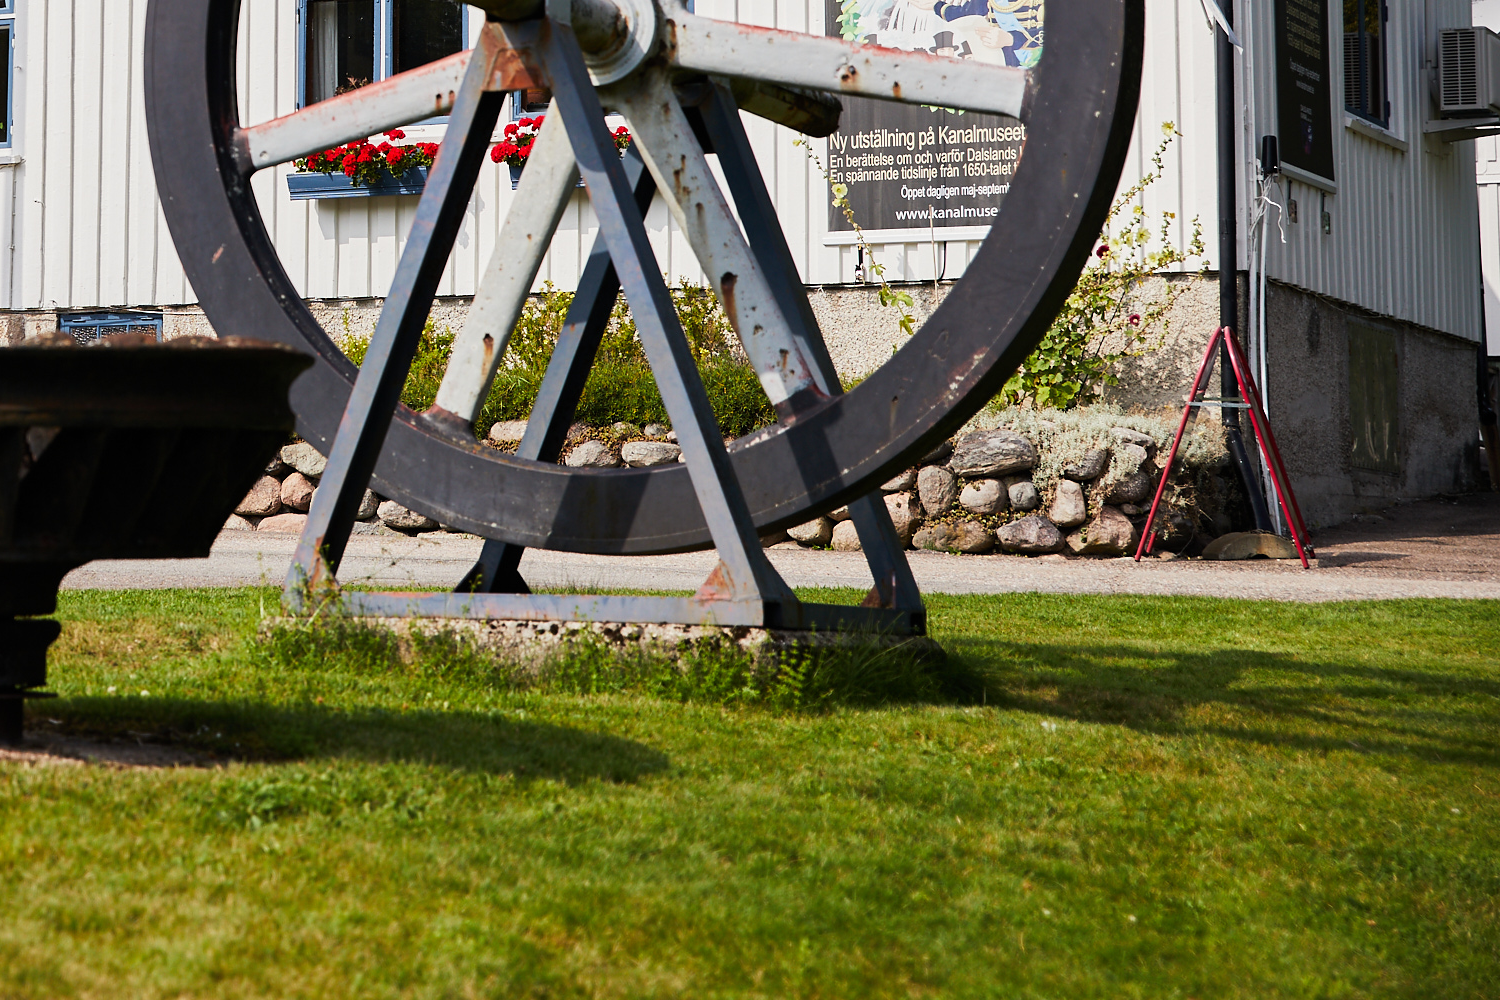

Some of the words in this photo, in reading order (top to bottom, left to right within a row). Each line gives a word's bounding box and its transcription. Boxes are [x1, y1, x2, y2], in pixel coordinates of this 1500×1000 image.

[829, 132, 848, 154] Ny
[850, 128, 915, 151] utställning
[918, 126, 935, 150] på
[938, 123, 1026, 145] Kanalmuseet
[830, 154, 844, 168] En
[846, 151, 894, 168] berättelse
[896, 153, 913, 165] om
[915, 150, 933, 164] och
[935, 147, 965, 163] varför
[967, 145, 1017, 162] Dalslands
[830, 169, 844, 183] En
[845, 166, 899, 185] spännande
[901, 164, 938, 181] tidslinje
[940, 162, 960, 178] från
[962, 161, 1012, 177] 1650-talet
[901, 184, 925, 200] Öppet
[927, 184, 960, 199] dagligen
